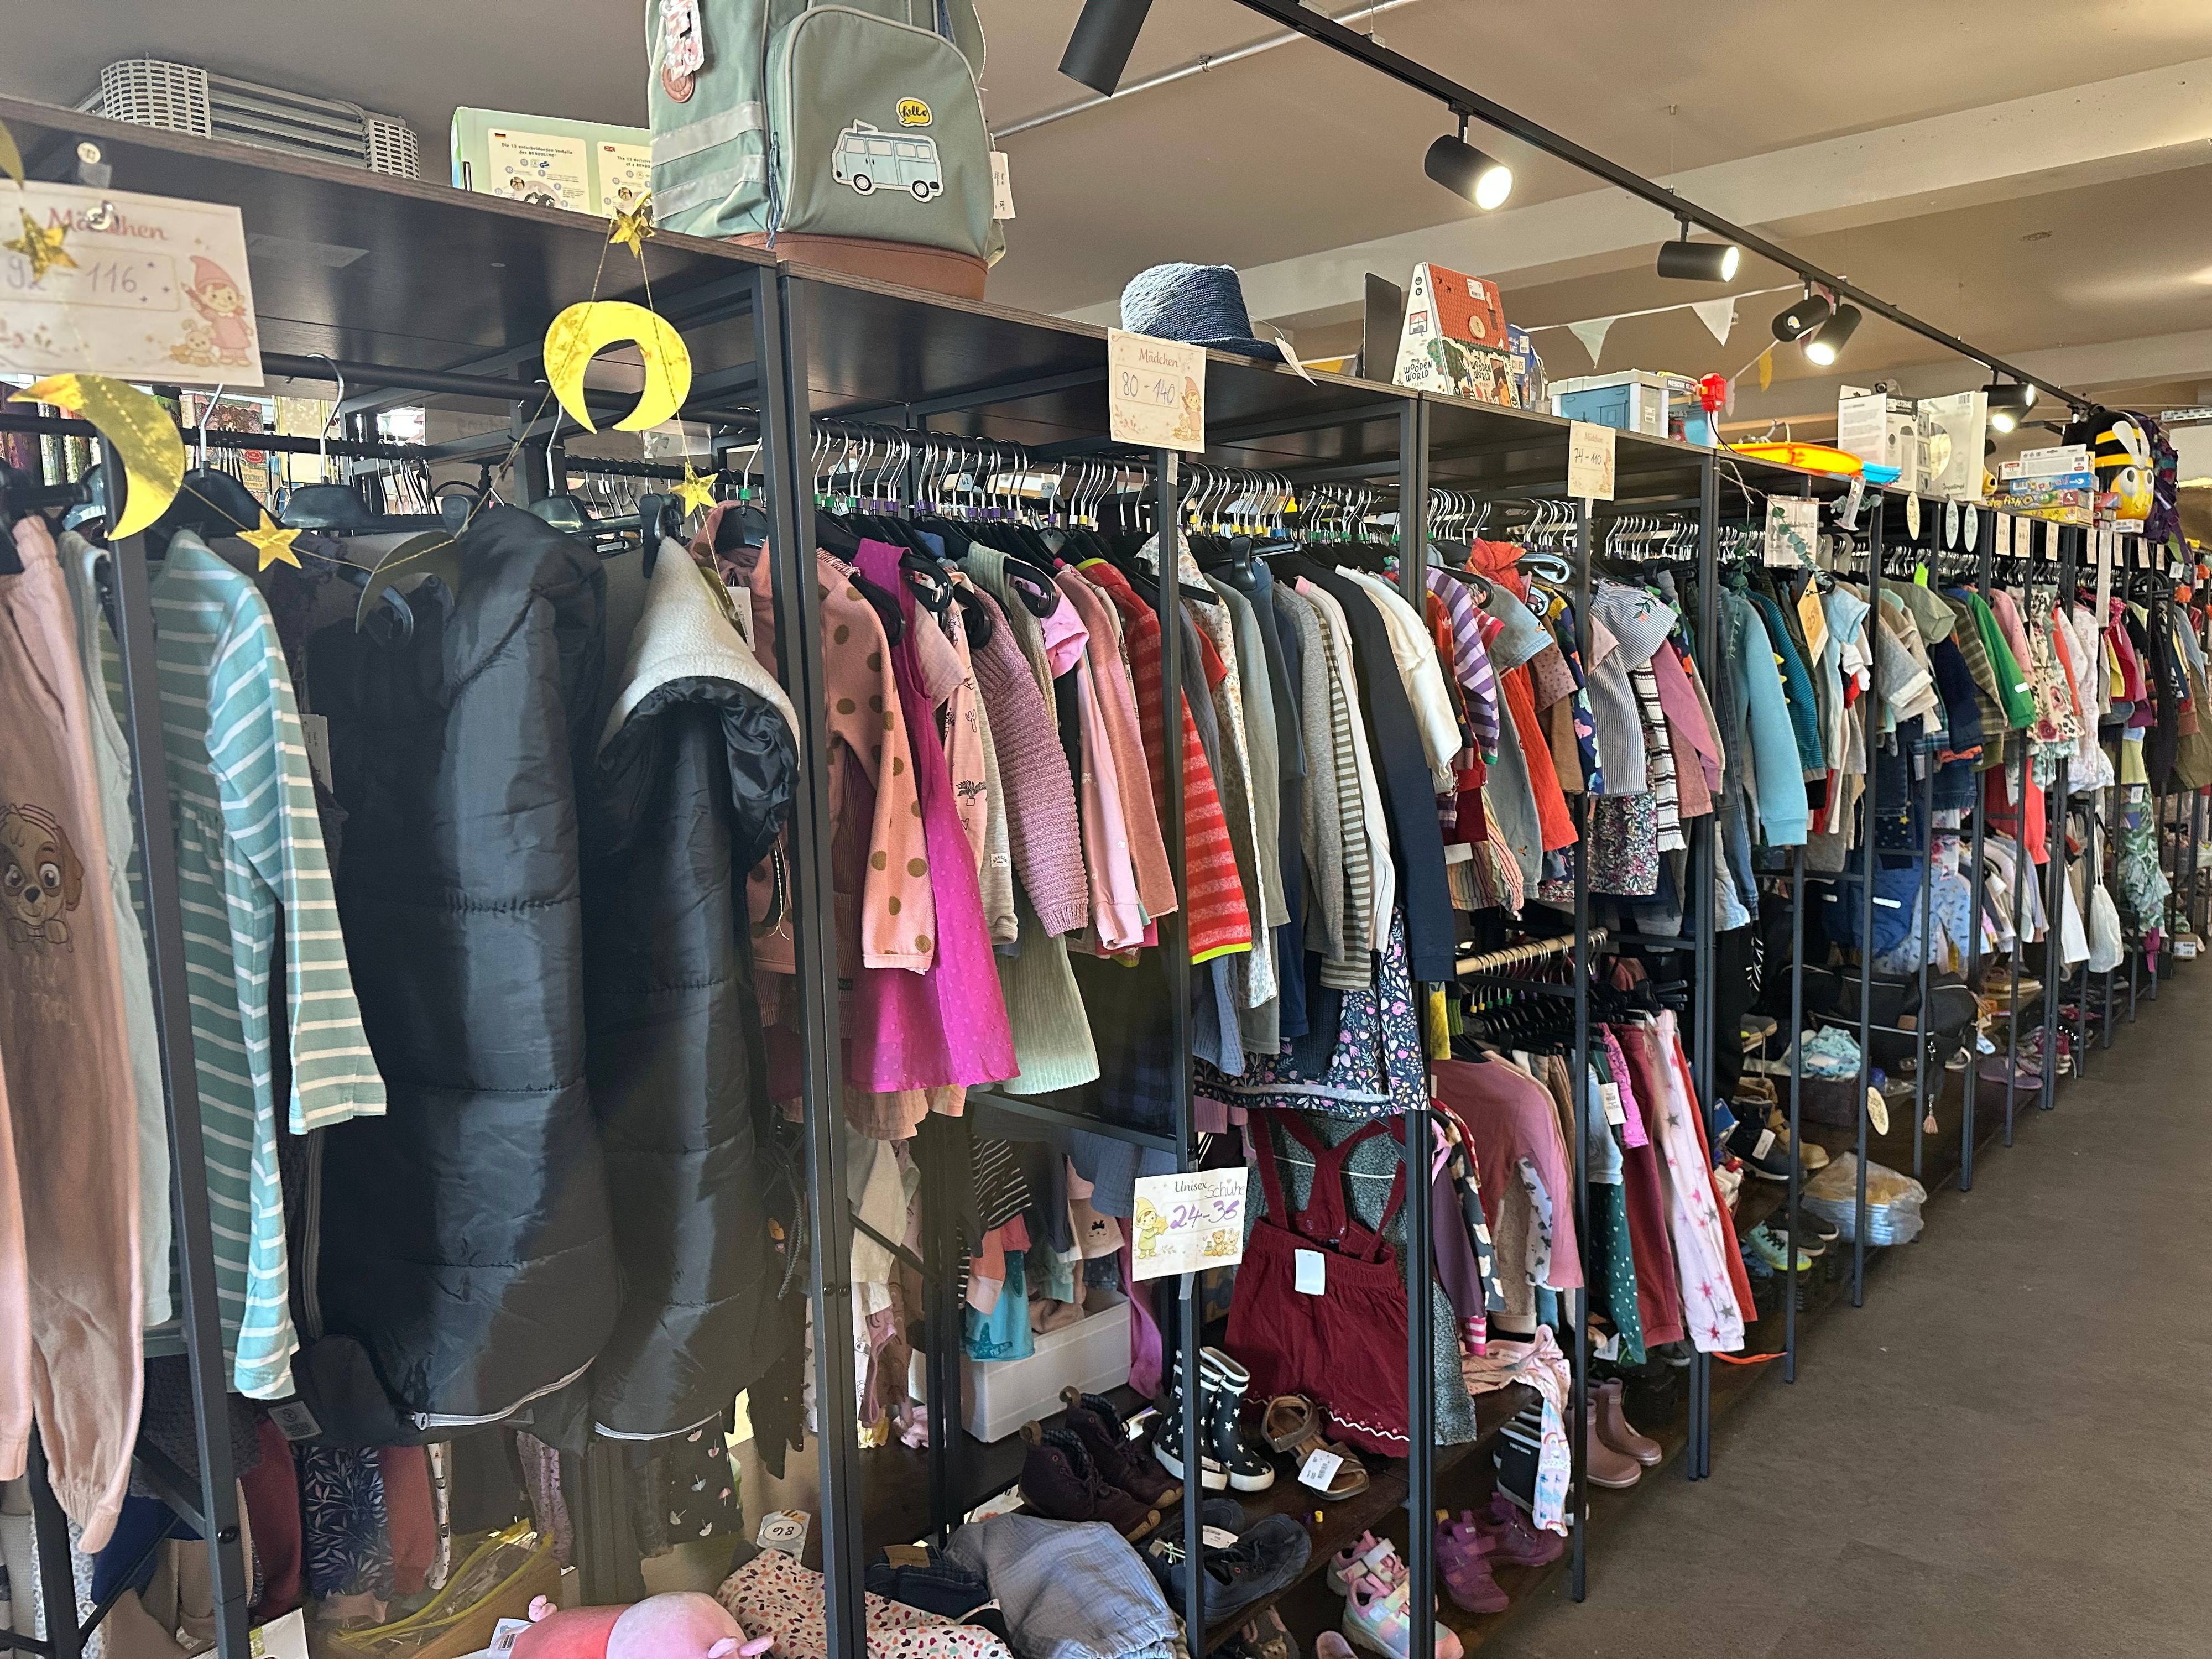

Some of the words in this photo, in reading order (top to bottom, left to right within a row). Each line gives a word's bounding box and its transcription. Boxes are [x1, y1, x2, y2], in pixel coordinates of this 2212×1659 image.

[902, 106, 927, 117] hello
[86, 262, 137, 293] 116
[1139, 348, 1178, 367] Mädchen
[1406, 370, 1429, 382] WORLD
[1474, 369, 1491, 381] WORLD
[1123, 372, 1138, 397] 80
[1152, 378, 1176, 405] 140
[1667, 380, 1685, 388] RESCUE
[1175, 1181, 1207, 1192] Unisex
[1204, 1182, 1245, 1198] Schuhe
[773, 1526, 795, 1536] 98
